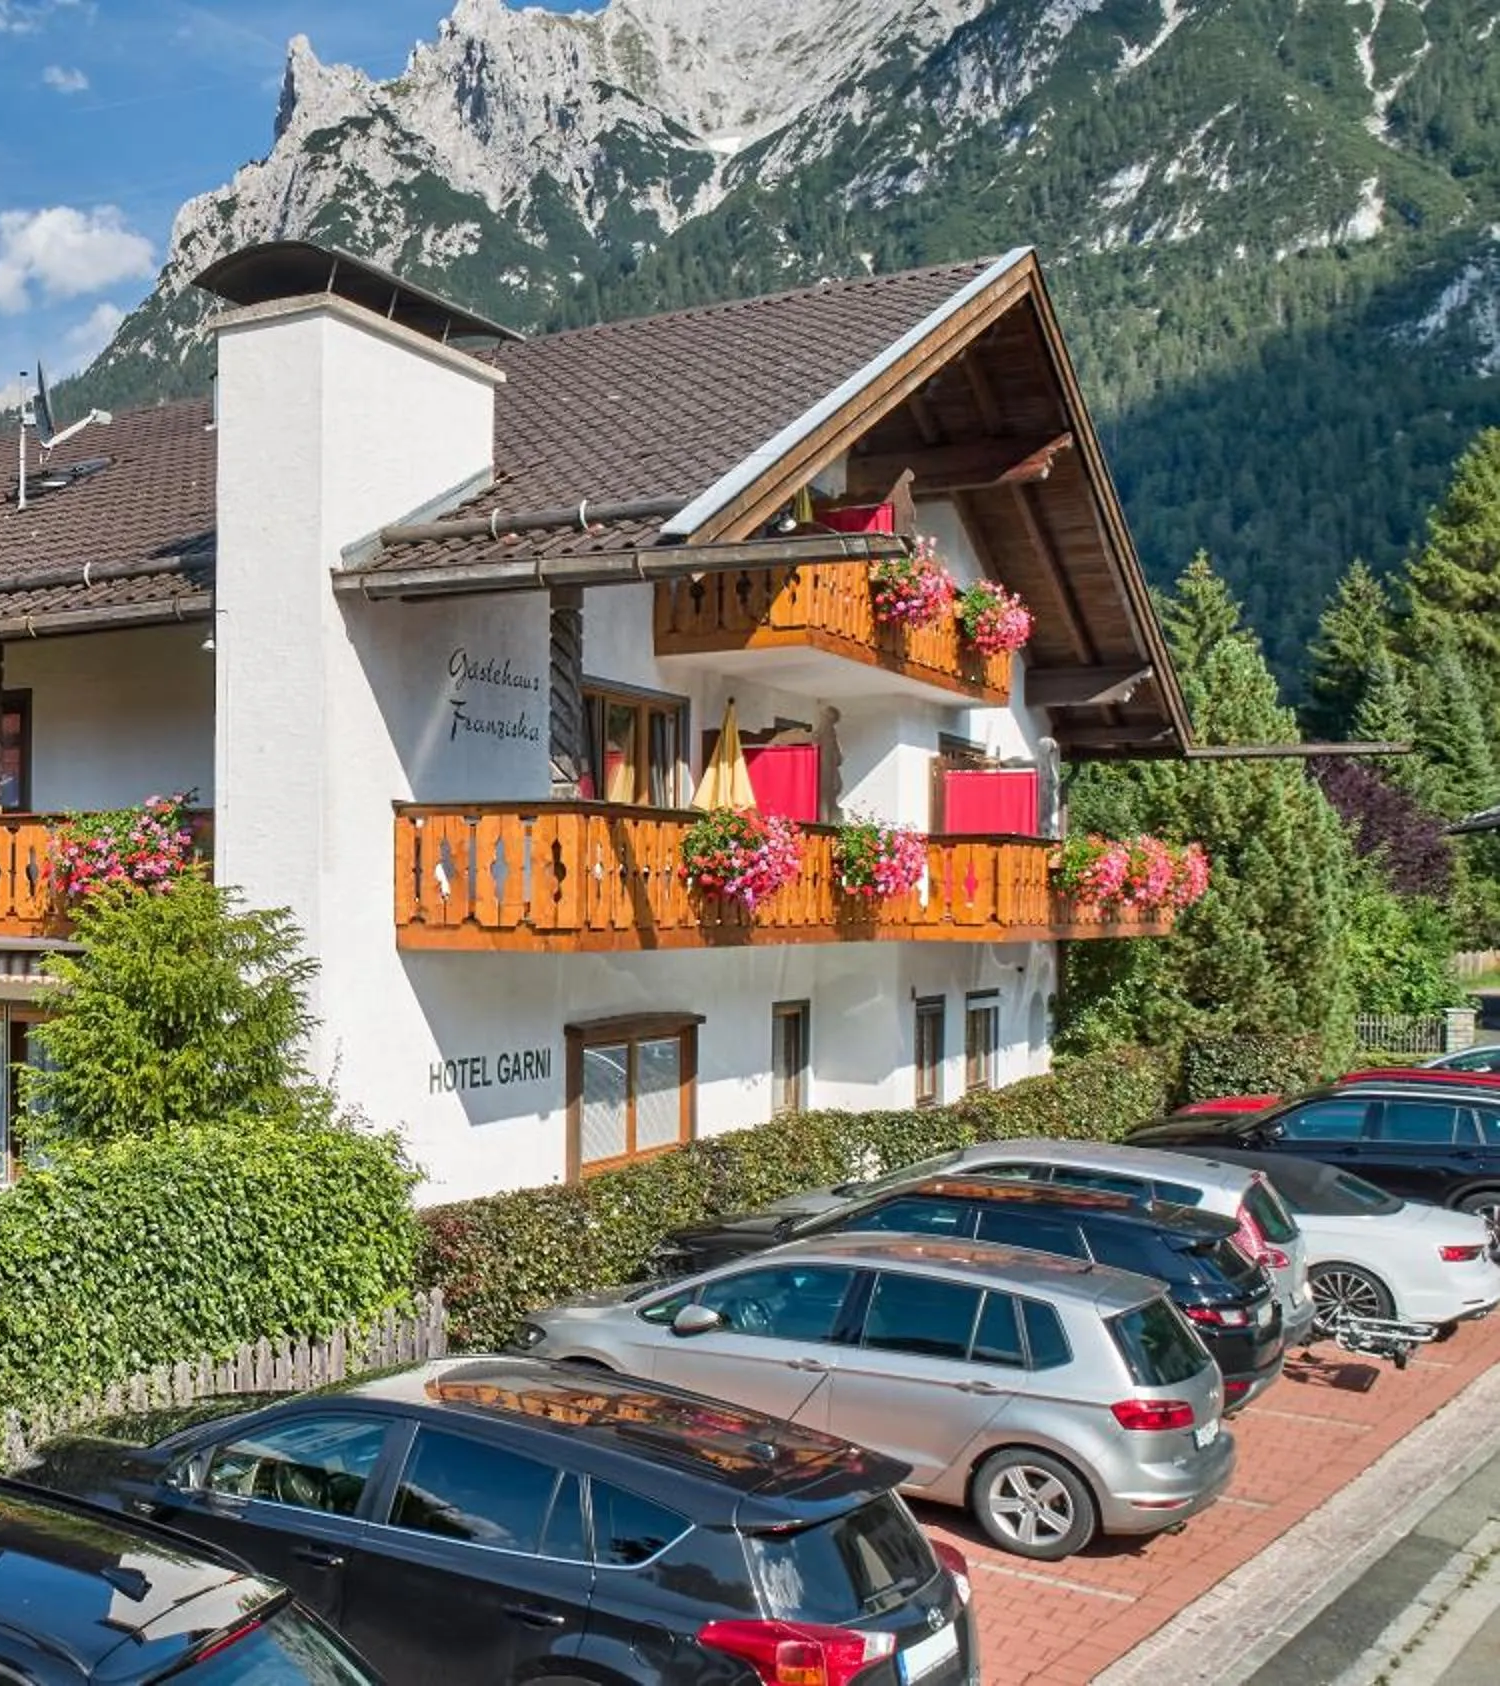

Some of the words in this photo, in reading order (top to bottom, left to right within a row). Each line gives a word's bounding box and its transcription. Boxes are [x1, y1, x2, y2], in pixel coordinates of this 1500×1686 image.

[449, 699, 539, 742] Franziska
[429, 1056, 492, 1094] HOTEL
[497, 1047, 551, 1084] GARNI
